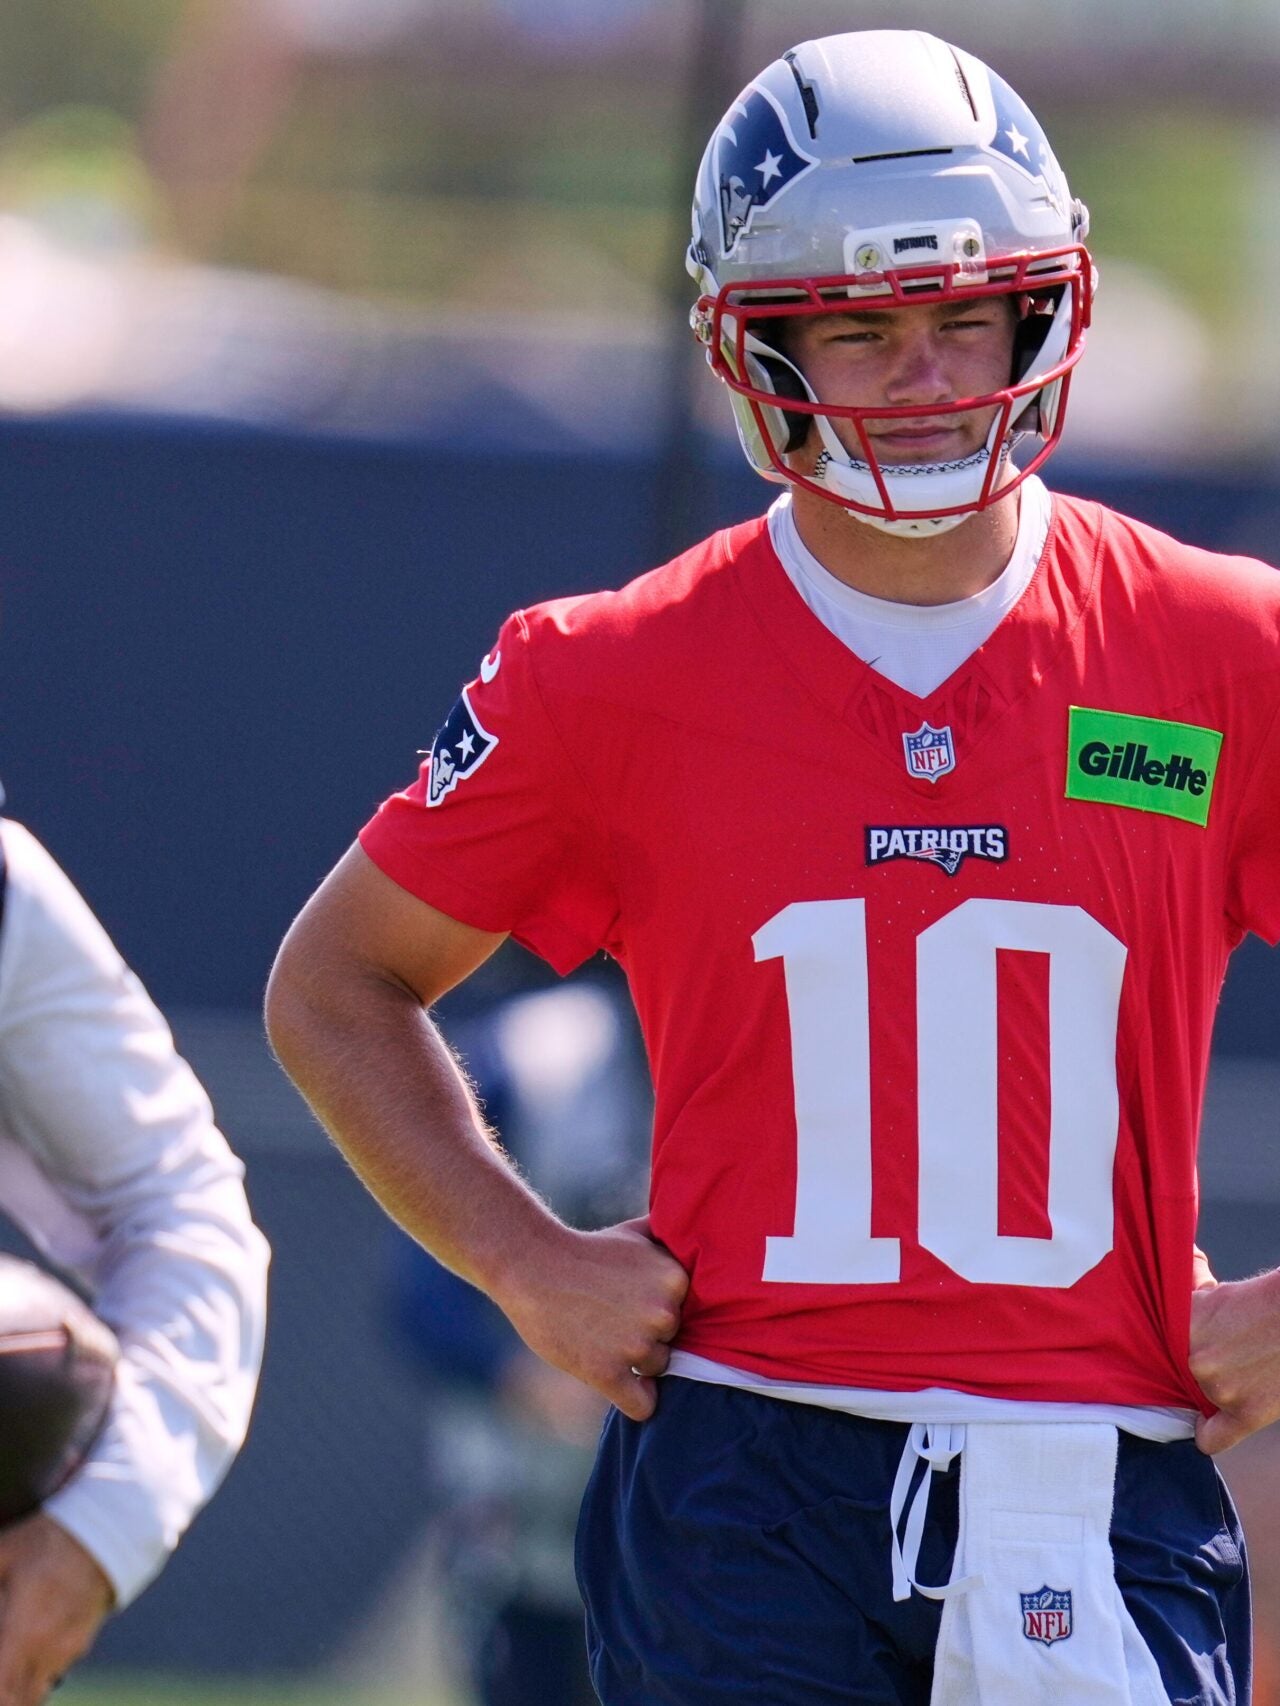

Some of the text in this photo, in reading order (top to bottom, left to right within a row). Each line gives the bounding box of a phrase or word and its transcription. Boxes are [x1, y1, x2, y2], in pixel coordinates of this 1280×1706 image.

[893, 234, 938, 255] PATRIOTS
[912, 747, 948, 771] NFL
[1078, 741, 1208, 796] Gillette
[870, 828, 1005, 860] PATRIOTS
[751, 897, 1128, 1288] 10
[1026, 1611, 1068, 1640] NFL
